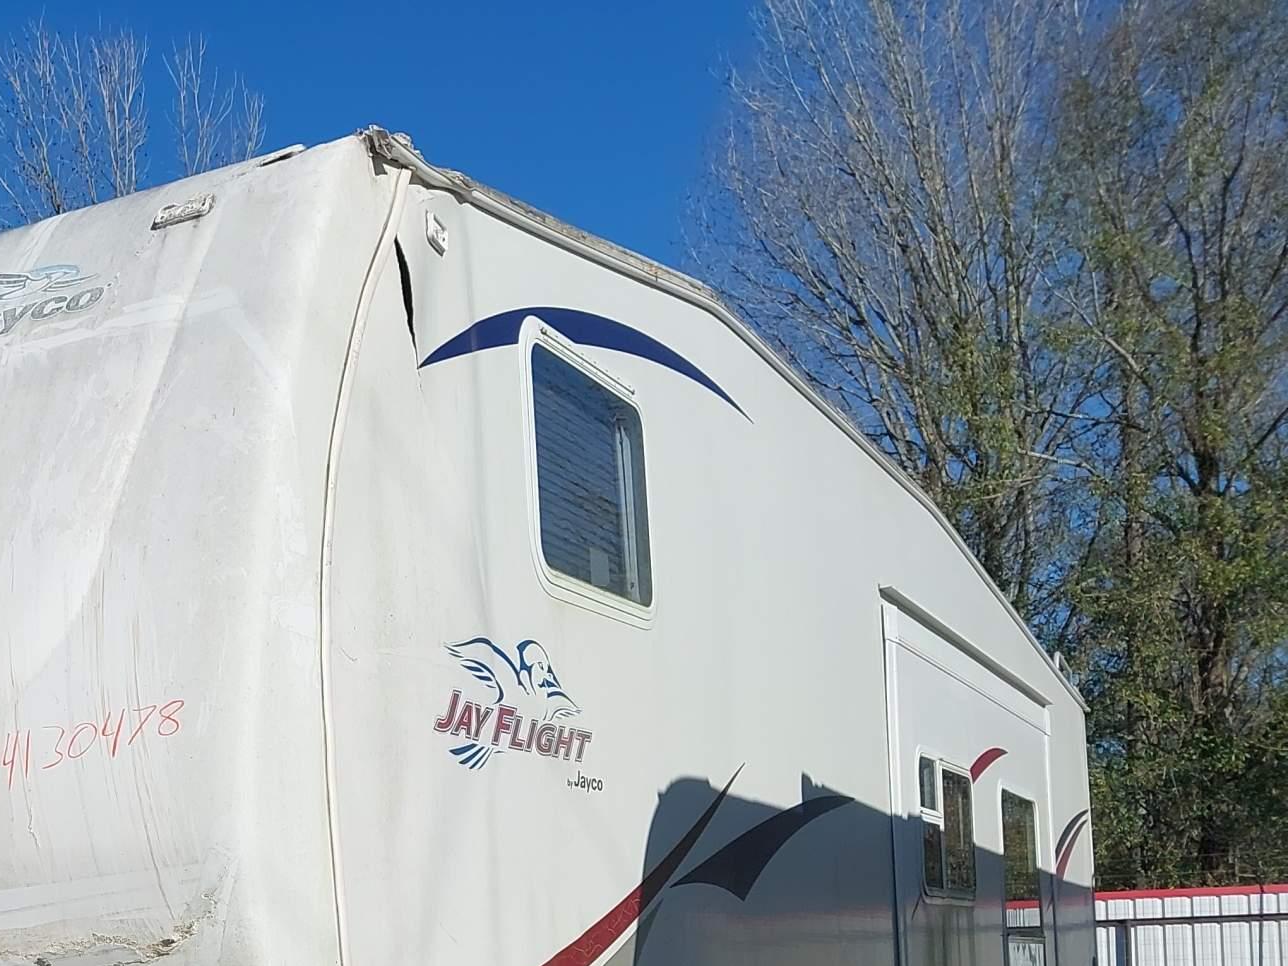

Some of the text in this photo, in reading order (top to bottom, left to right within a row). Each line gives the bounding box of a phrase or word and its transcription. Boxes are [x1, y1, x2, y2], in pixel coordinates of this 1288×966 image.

[433, 689, 592, 763] JAY FLIGHT
[567, 770, 604, 793] by Jayco
